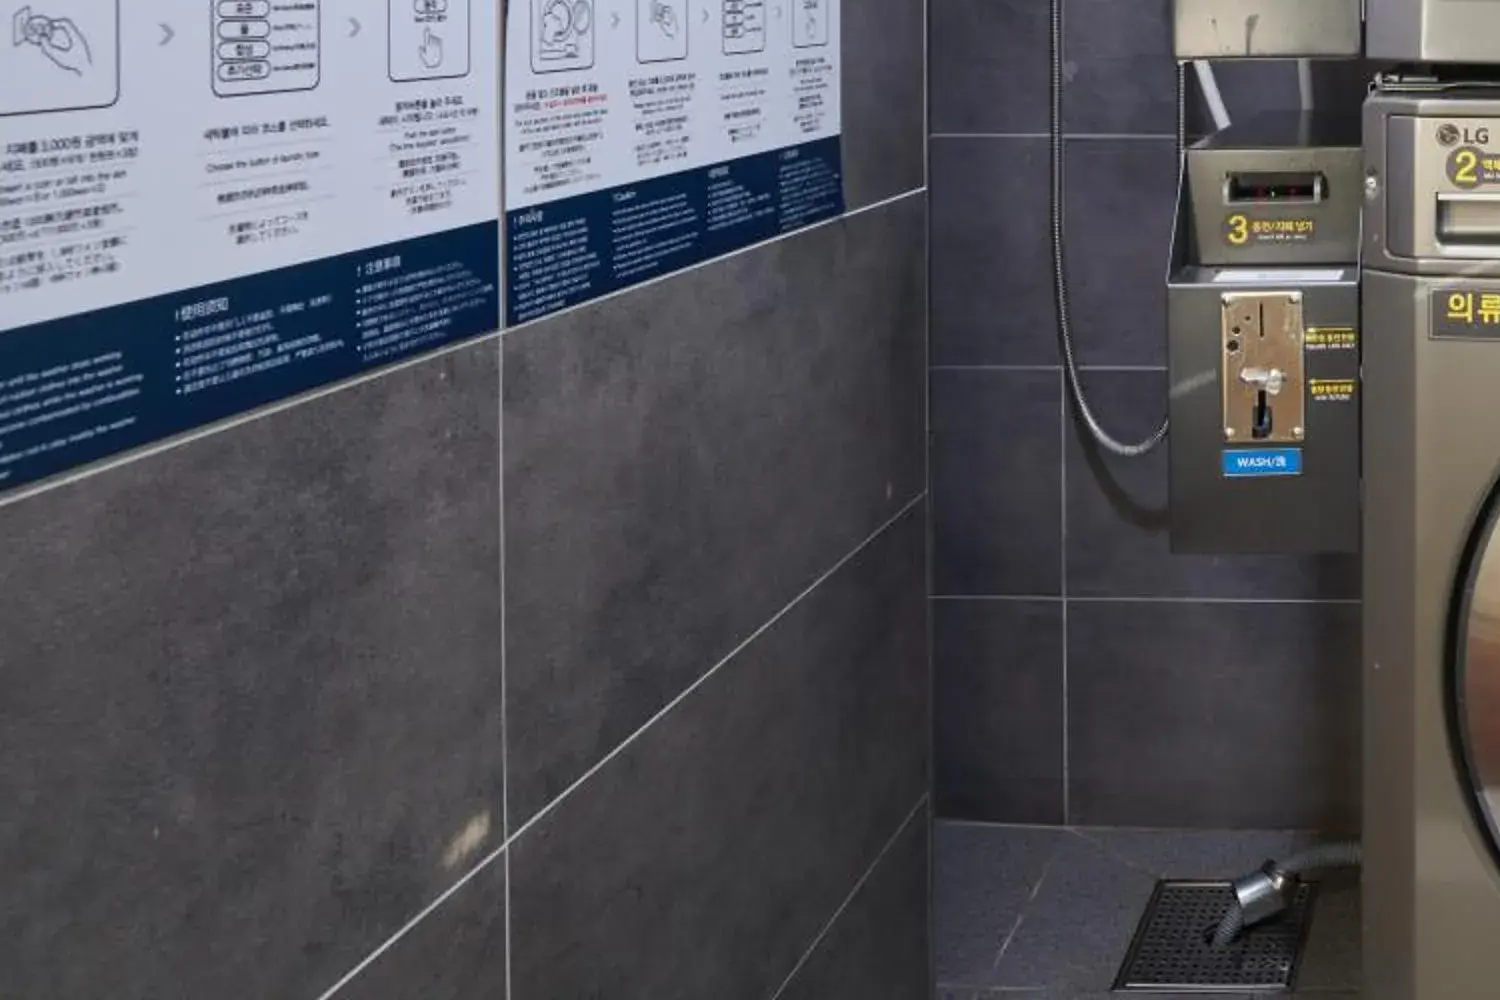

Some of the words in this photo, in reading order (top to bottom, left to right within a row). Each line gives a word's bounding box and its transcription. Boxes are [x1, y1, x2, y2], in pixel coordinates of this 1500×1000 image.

[1463, 127, 1489, 144] LG
[1455, 152, 1477, 182] 2
[1228, 215, 1248, 244] 3
